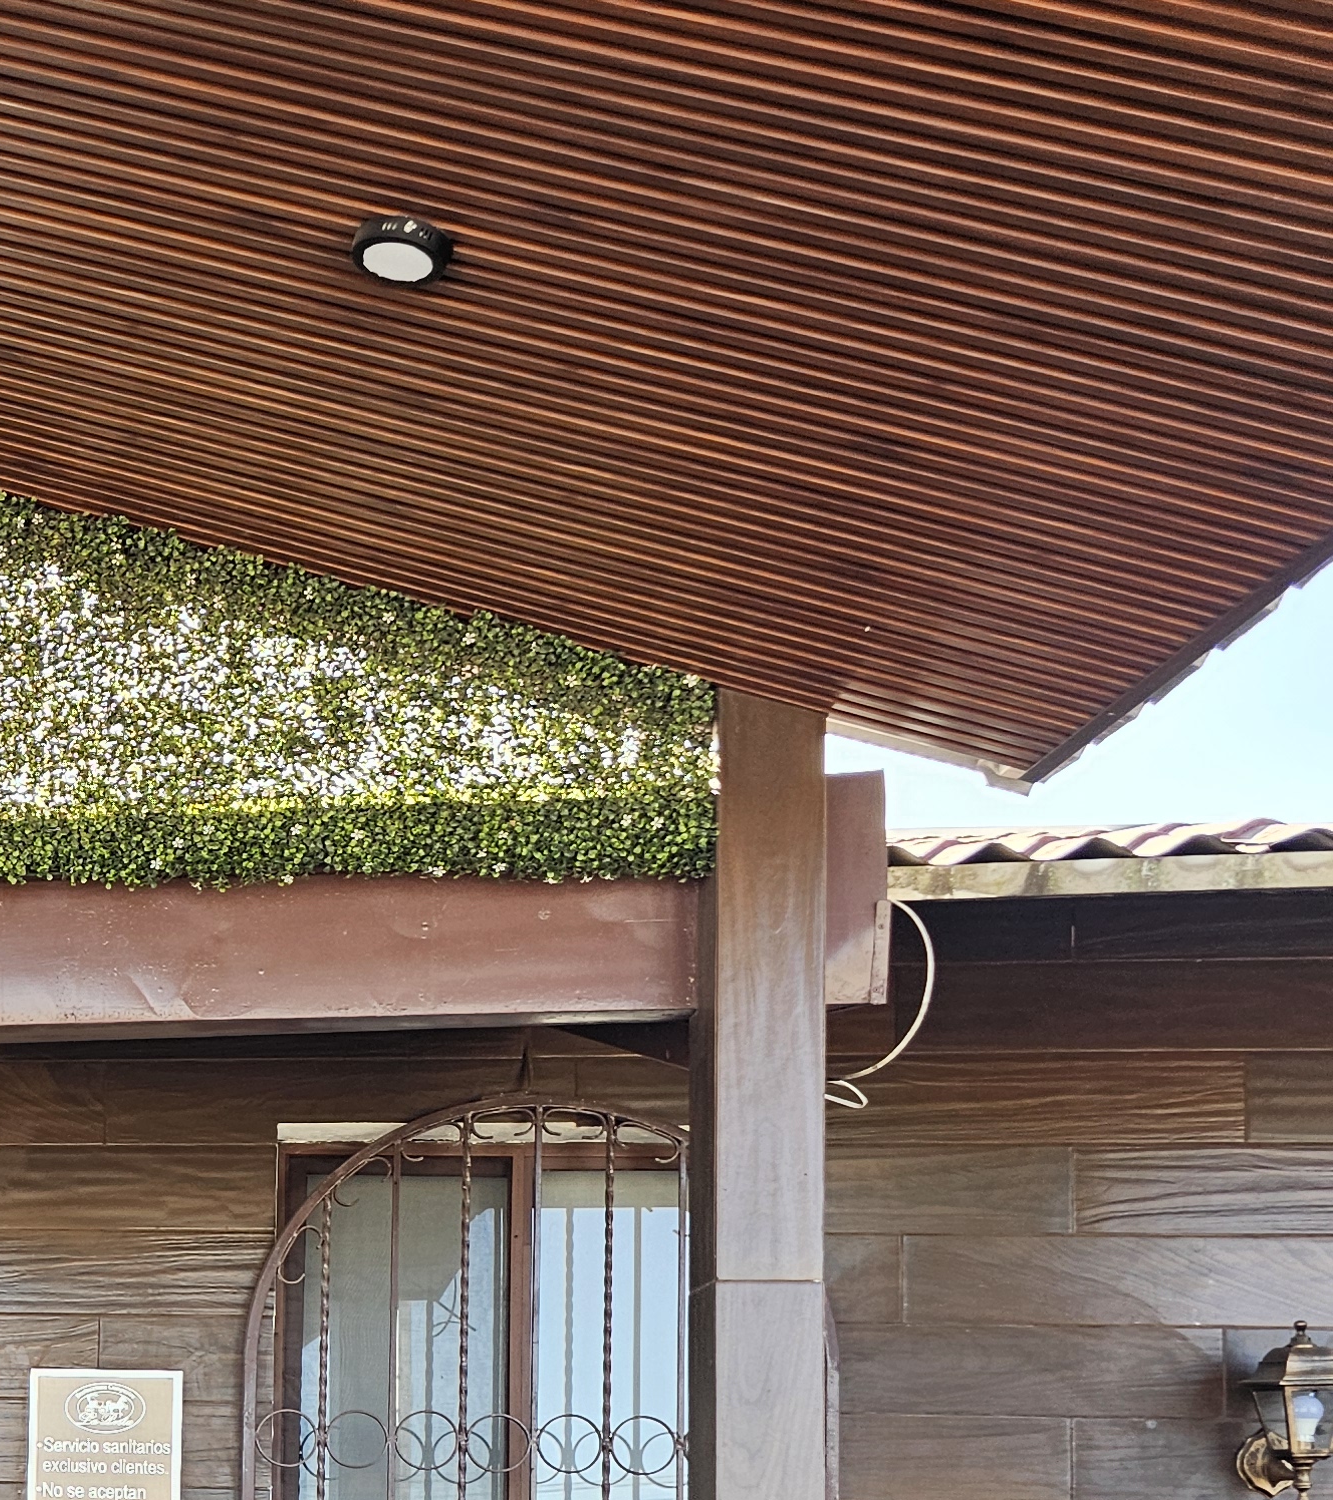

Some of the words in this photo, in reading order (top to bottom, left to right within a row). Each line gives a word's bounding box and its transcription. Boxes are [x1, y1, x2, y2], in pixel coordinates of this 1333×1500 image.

[43, 1437, 99, 1454] Servicio
[103, 1438, 171, 1455] sanitarios
[42, 1459, 107, 1474] exclusivo
[42, 1482, 63, 1498] No
[67, 1486, 84, 1499] se
